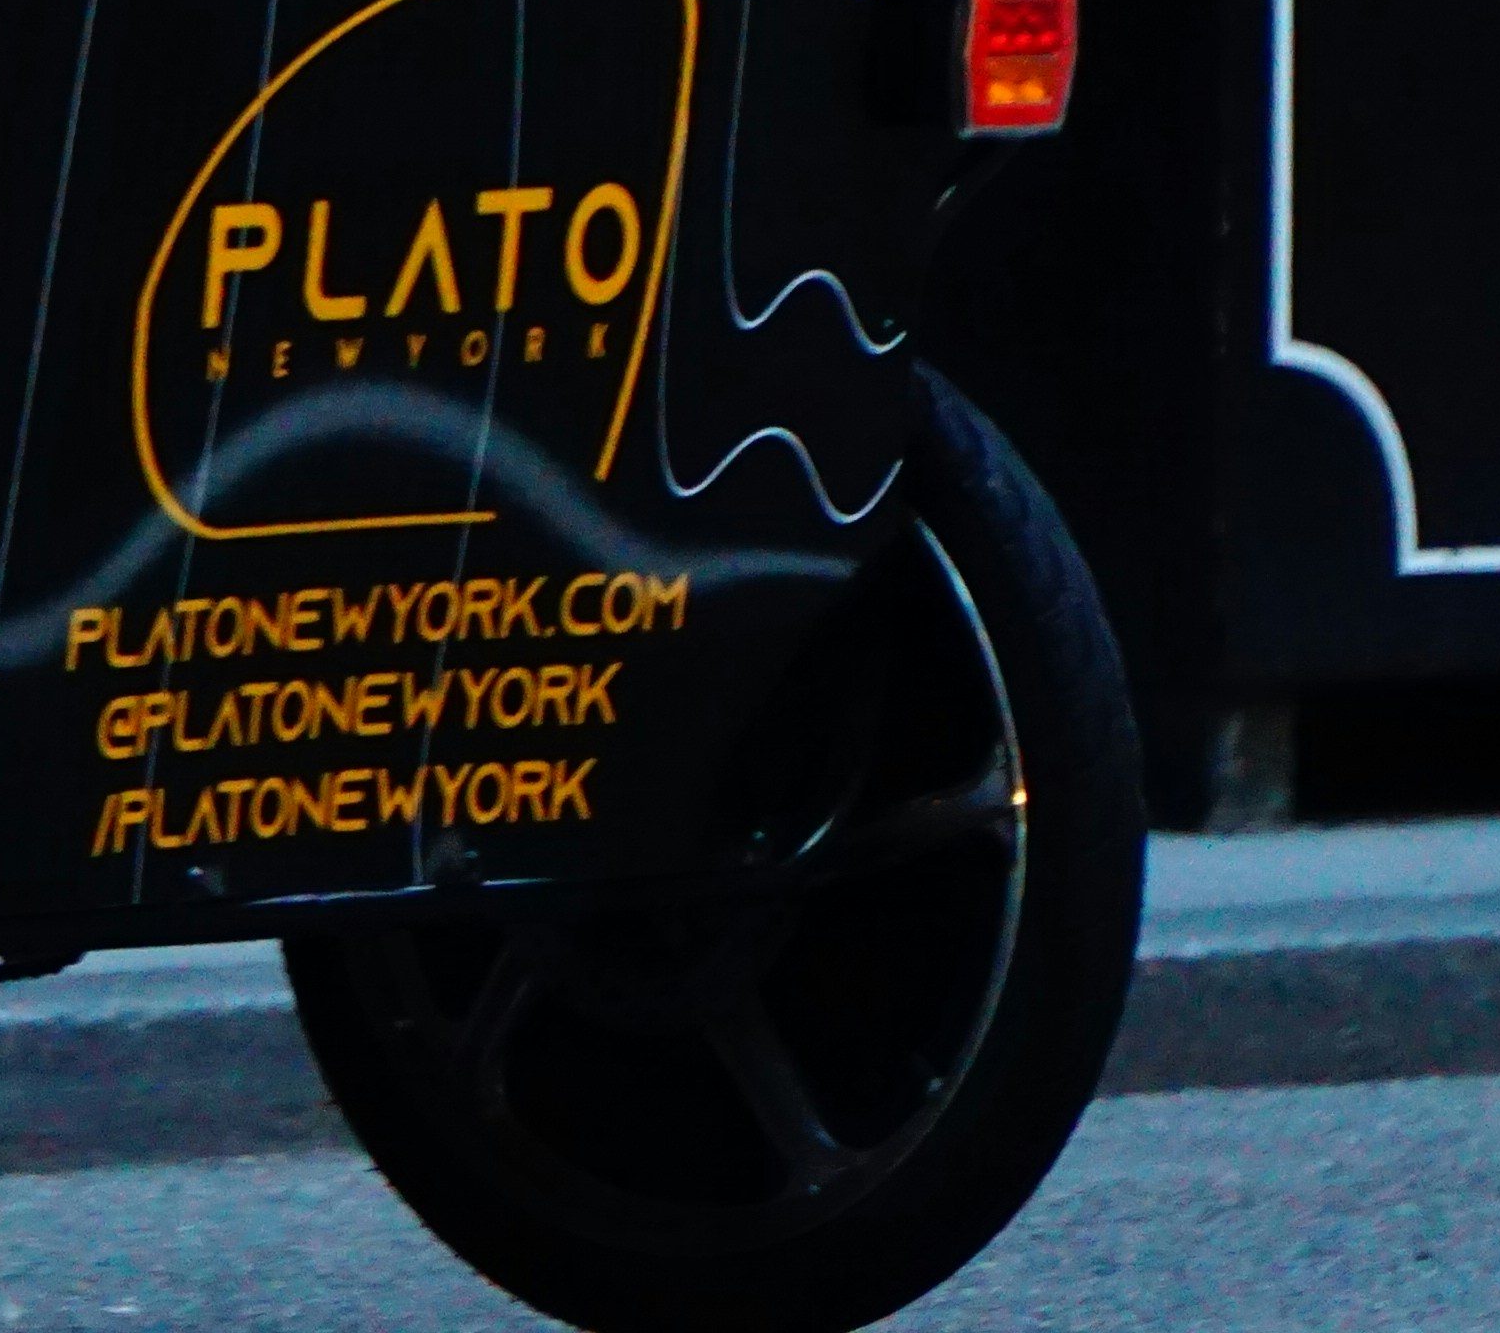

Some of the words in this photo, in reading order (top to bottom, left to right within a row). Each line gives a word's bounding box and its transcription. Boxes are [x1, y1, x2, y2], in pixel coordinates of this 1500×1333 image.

[201, 181, 642, 330] PLATO
[64, 571, 690, 673] PLATONEWYORK.COM
[97, 660, 624, 761] @PLATONEWYORK
